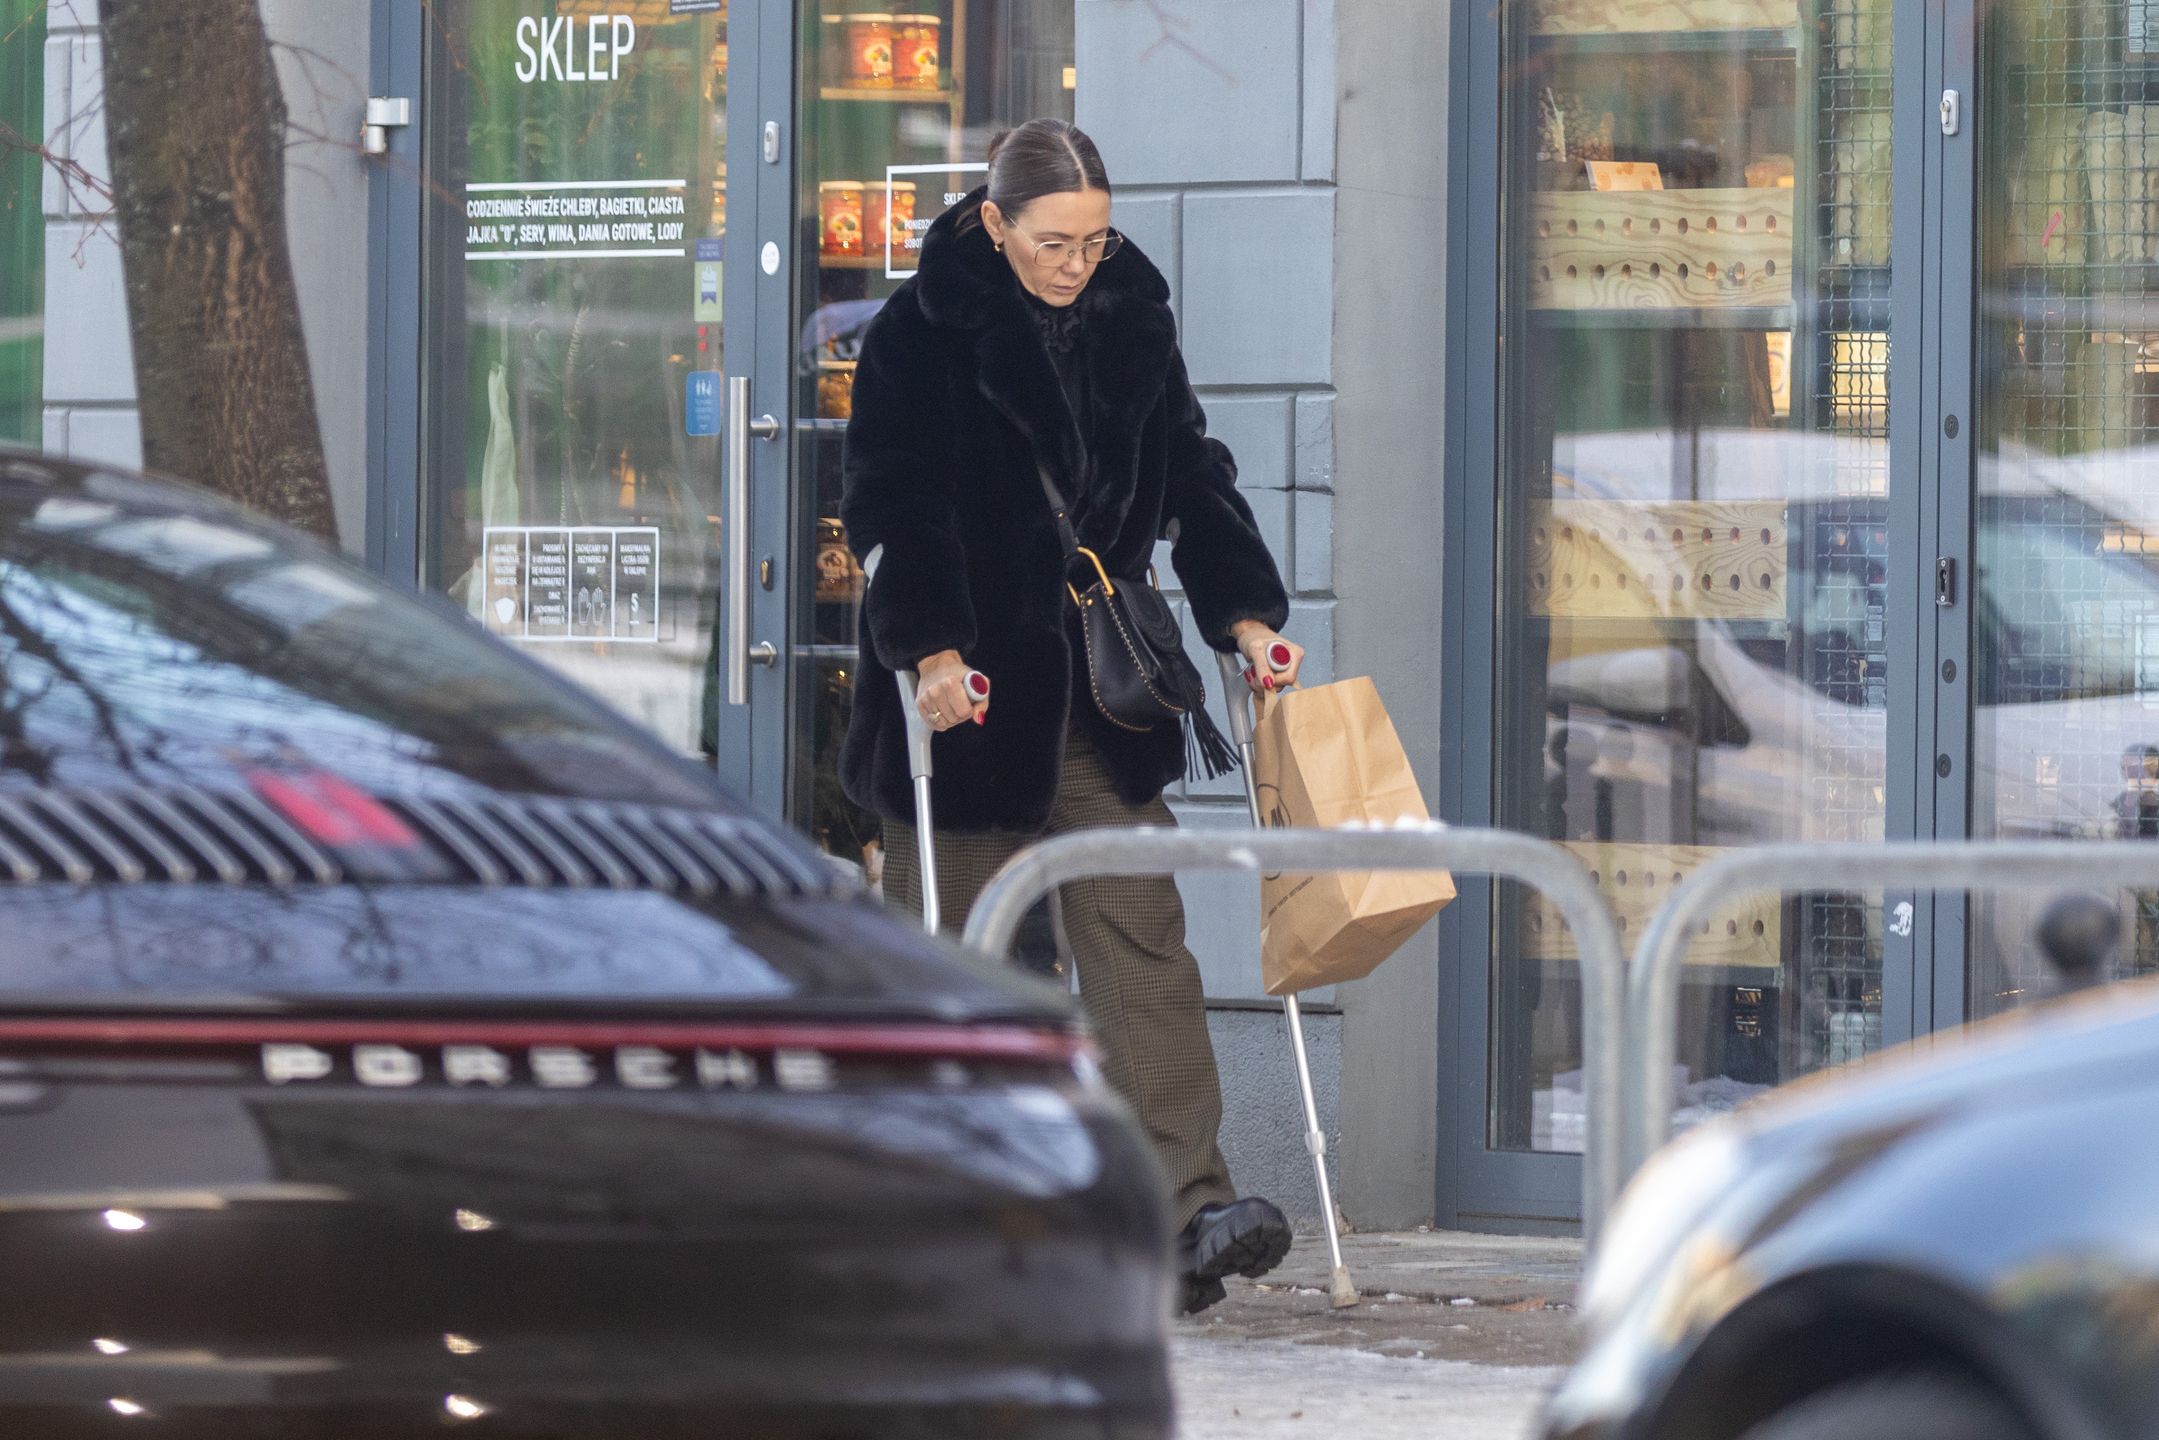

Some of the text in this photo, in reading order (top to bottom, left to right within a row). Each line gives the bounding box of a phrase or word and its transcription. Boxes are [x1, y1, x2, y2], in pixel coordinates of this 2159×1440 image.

[515, 15, 635, 83] SKLEP
[466, 194, 685, 219] CODZIENNIE ŚWIEŻE CHLEBY, BAGIETKI, CIASTA
[466, 225, 499, 244] JAJKA
[520, 224, 546, 246] SERY,
[547, 224, 577, 245] WINA,
[578, 223, 610, 242] DANIA
[611, 222, 656, 244] GOTOWE,
[657, 221, 684, 241] LODY
[261, 1044, 836, 1091] PORSCHE
